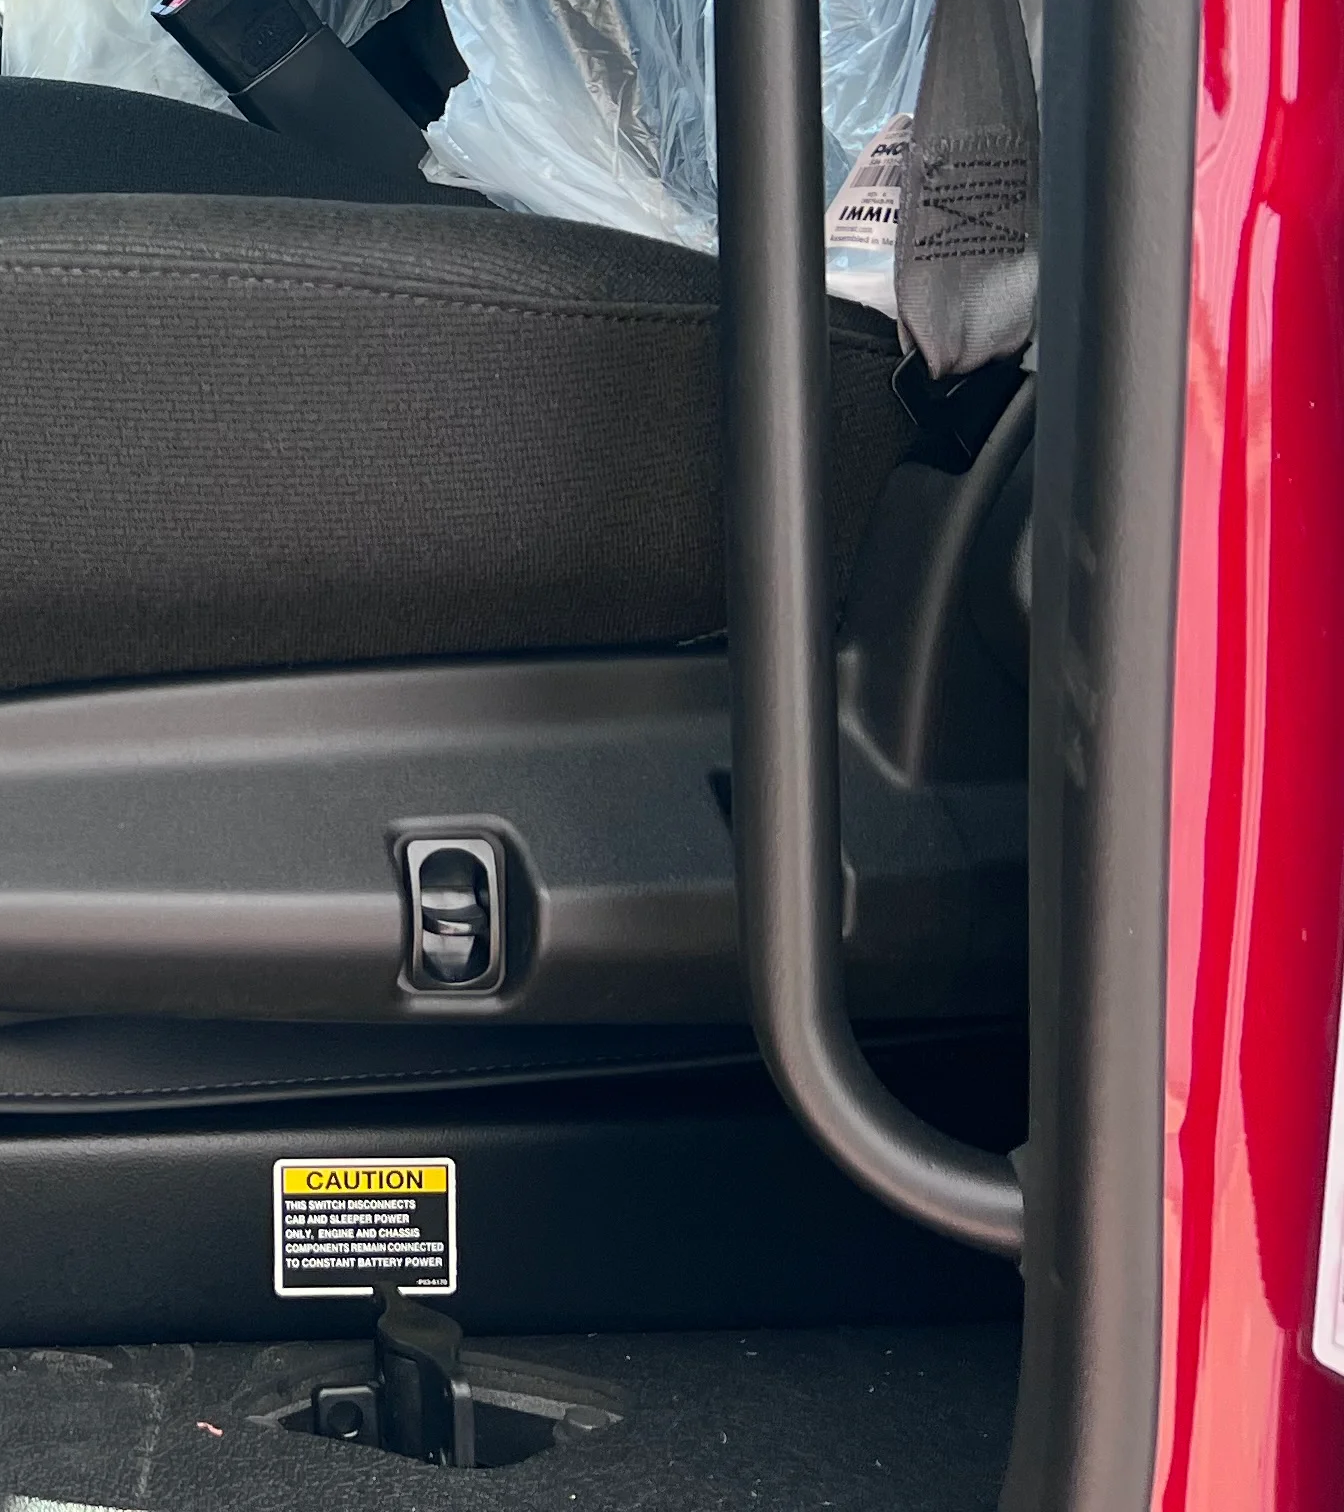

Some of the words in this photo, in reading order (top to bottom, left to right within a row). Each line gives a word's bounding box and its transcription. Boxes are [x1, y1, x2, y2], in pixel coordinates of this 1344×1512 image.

[306, 1170, 424, 1190] CAUTION
[285, 1199, 307, 1210] THIS
[308, 1199, 346, 1210] SWITCH
[347, 1199, 416, 1210] DISCONNECTS
[285, 1214, 306, 1225] CAB
[306, 1214, 328, 1225] AND
[329, 1214, 373, 1224] SLEEPER
[374, 1214, 410, 1224] POWER
[318, 1228, 355, 1239] ENGINE
[356, 1228, 377, 1238] AND
[378, 1228, 420, 1238] CHASSIS
[285, 1242, 350, 1254] COMPONENTS
[350, 1242, 387, 1253] REMAIN
[387, 1242, 445, 1252] CONNECTED
[285, 1257, 300, 1268] TO
[301, 1257, 356, 1268] CONSTANT
[357, 1257, 403, 1267] BATTERY
[404, 1257, 443, 1267] POWER
